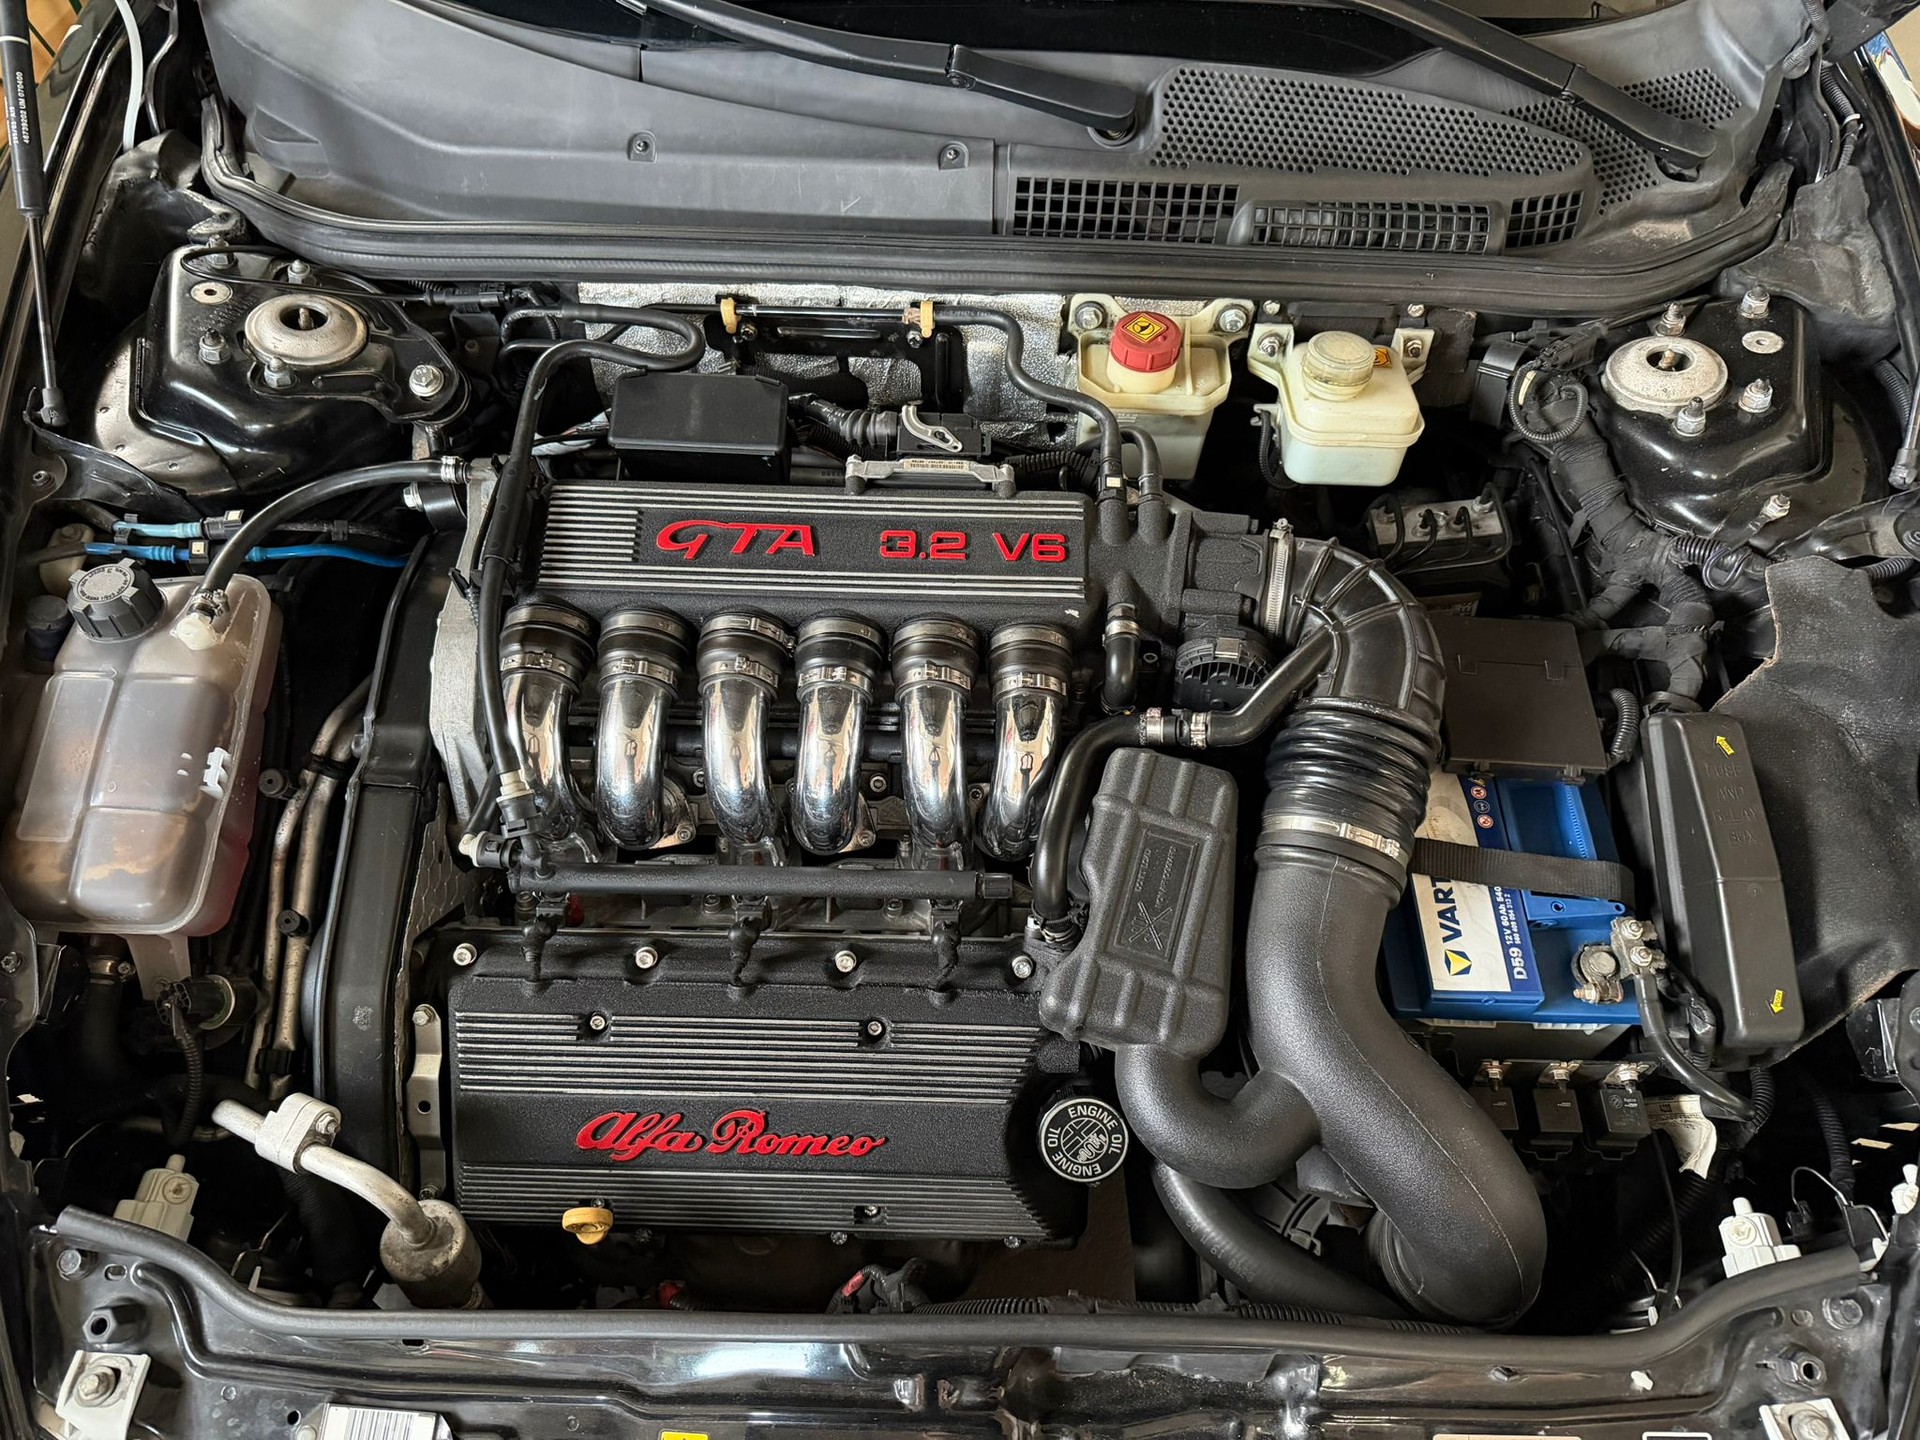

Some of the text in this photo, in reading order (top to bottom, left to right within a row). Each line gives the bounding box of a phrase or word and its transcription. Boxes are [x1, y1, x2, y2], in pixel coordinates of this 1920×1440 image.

[656, 519, 1067, 563] GTA 3.2 V6
[1503, 928, 1514, 945] 12V
[1509, 947, 1528, 980] D59
[575, 1109, 885, 1162] Alfa Romeo
[1047, 1127, 1102, 1176] ENGINE OIL
[1067, 1105, 1123, 1155] ENGINE OIL
